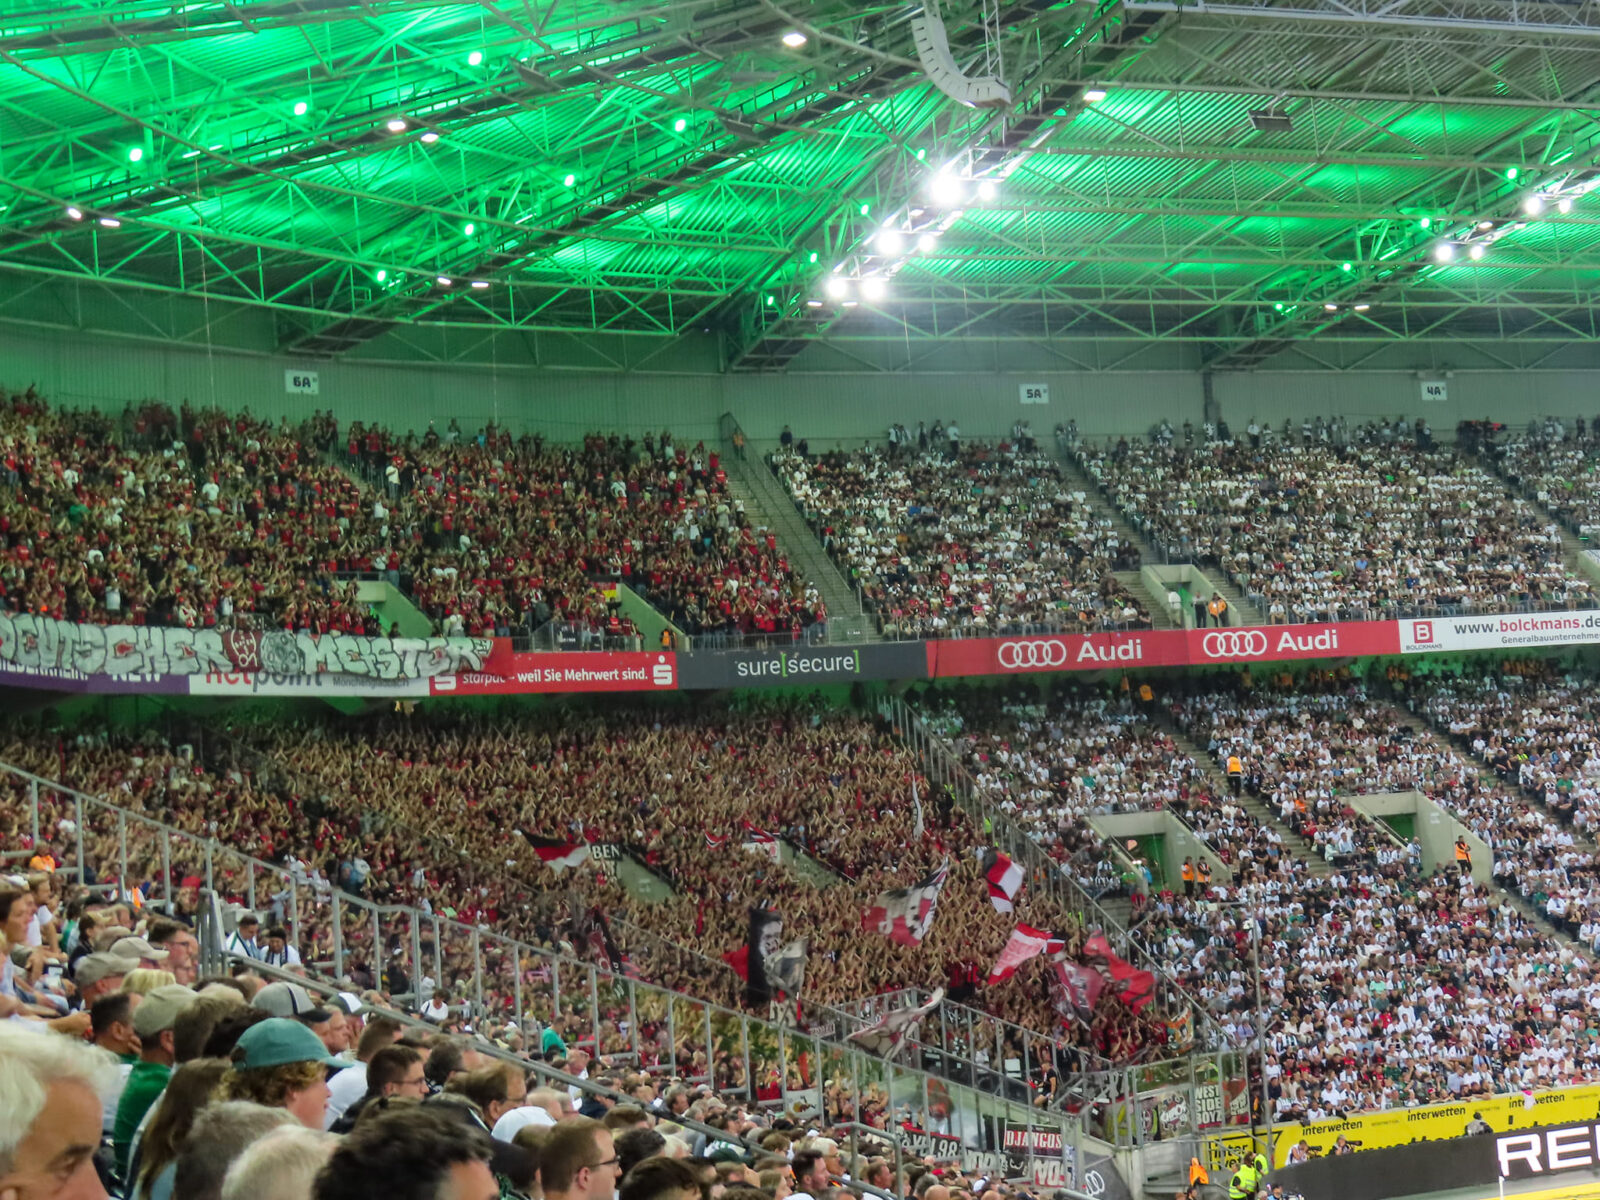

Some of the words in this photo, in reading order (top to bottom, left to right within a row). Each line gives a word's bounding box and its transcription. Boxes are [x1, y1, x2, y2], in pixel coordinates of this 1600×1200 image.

[1454, 615, 1600, 634] www.bolckmans.de
[1077, 639, 1142, 662] Audi
[1277, 629, 1338, 652] Audi
[738, 650, 859, 677] sure[secure]
[518, 669, 541, 682] weil
[544, 669, 562, 682] Sie
[565, 668, 619, 681] Mehrwert
[622, 667, 648, 680] sind.
[1407, 1107, 1466, 1122] interwetten
[1302, 1120, 1362, 1136] interwetten
[1497, 1124, 1600, 1176] RE
